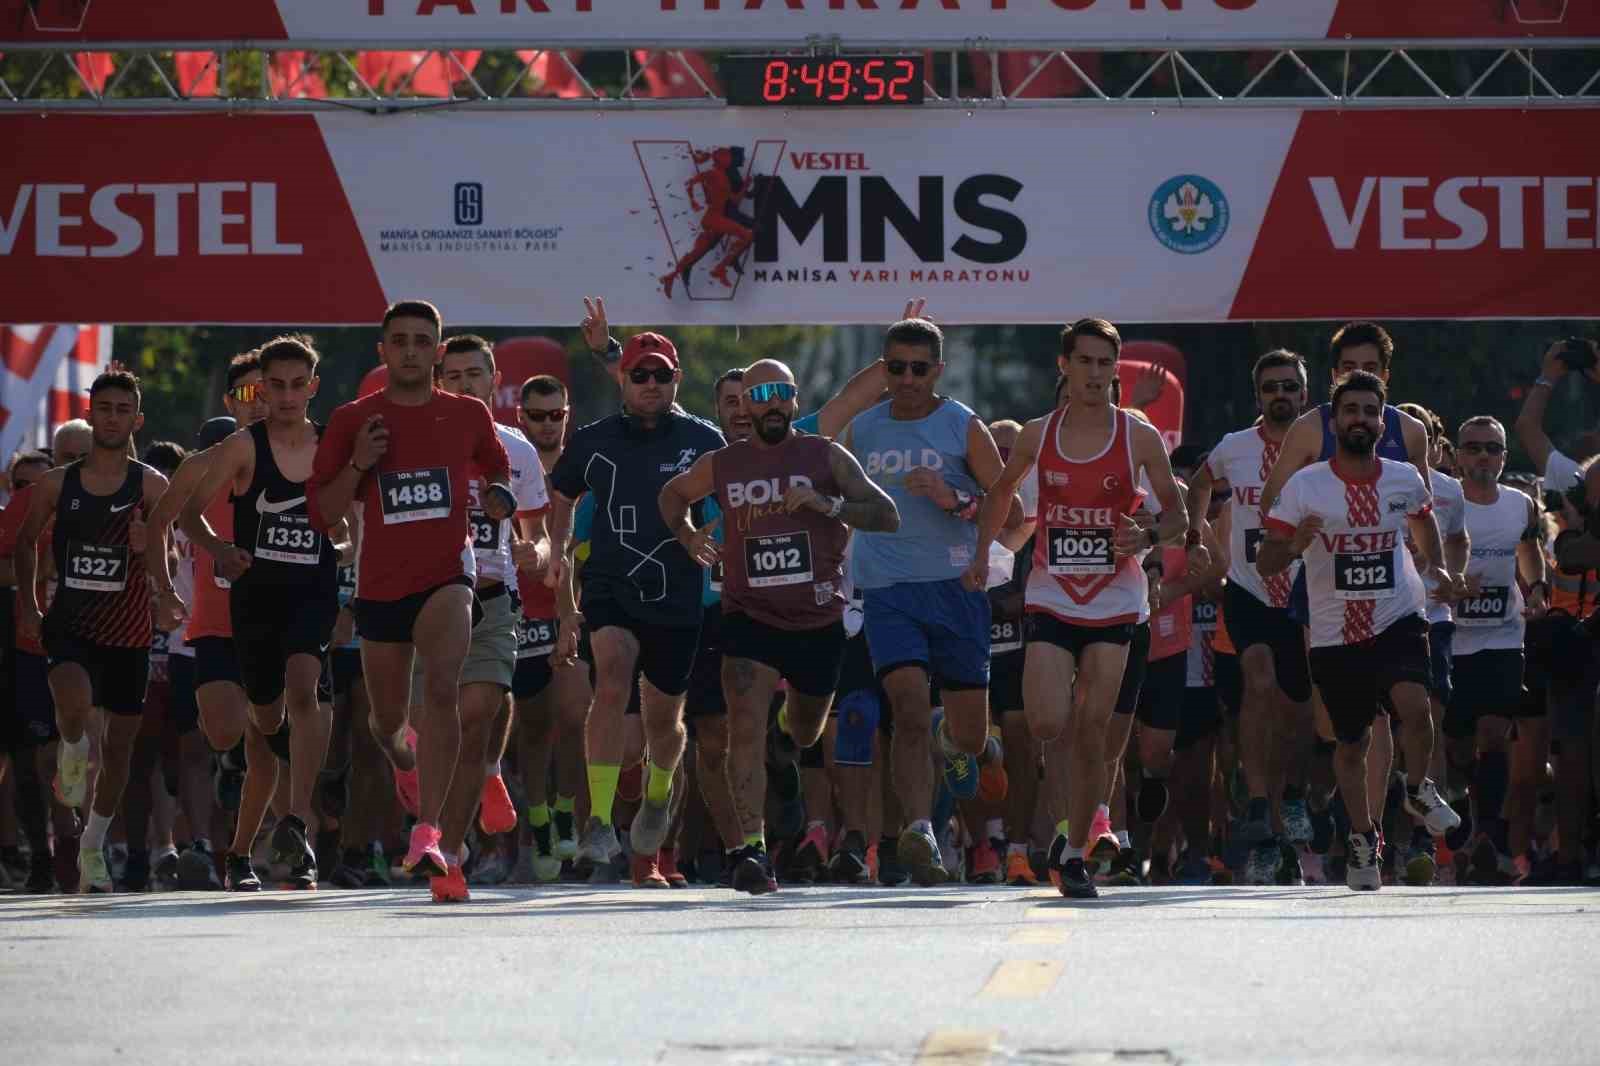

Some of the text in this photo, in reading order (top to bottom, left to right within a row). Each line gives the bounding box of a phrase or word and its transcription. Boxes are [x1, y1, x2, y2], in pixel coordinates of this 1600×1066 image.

[763, 59, 914, 102] 8:49:52
[790, 152, 869, 171] VESTEL
[754, 173, 1027, 264] MNS
[1308, 175, 1600, 251] VESTE
[754, 268, 1030, 281] MANİSA YARI MARATONU
[867, 448, 943, 475] BOLD
[388, 482, 443, 506] 1488
[1046, 502, 1115, 526] VESTEL
[266, 526, 315, 549] 1333
[1054, 537, 1108, 556] 1002
[72, 555, 121, 577] 1327
[752, 548, 801, 572] 1012
[1344, 565, 1387, 585] 1312
[1463, 597, 1503, 614] 1400
